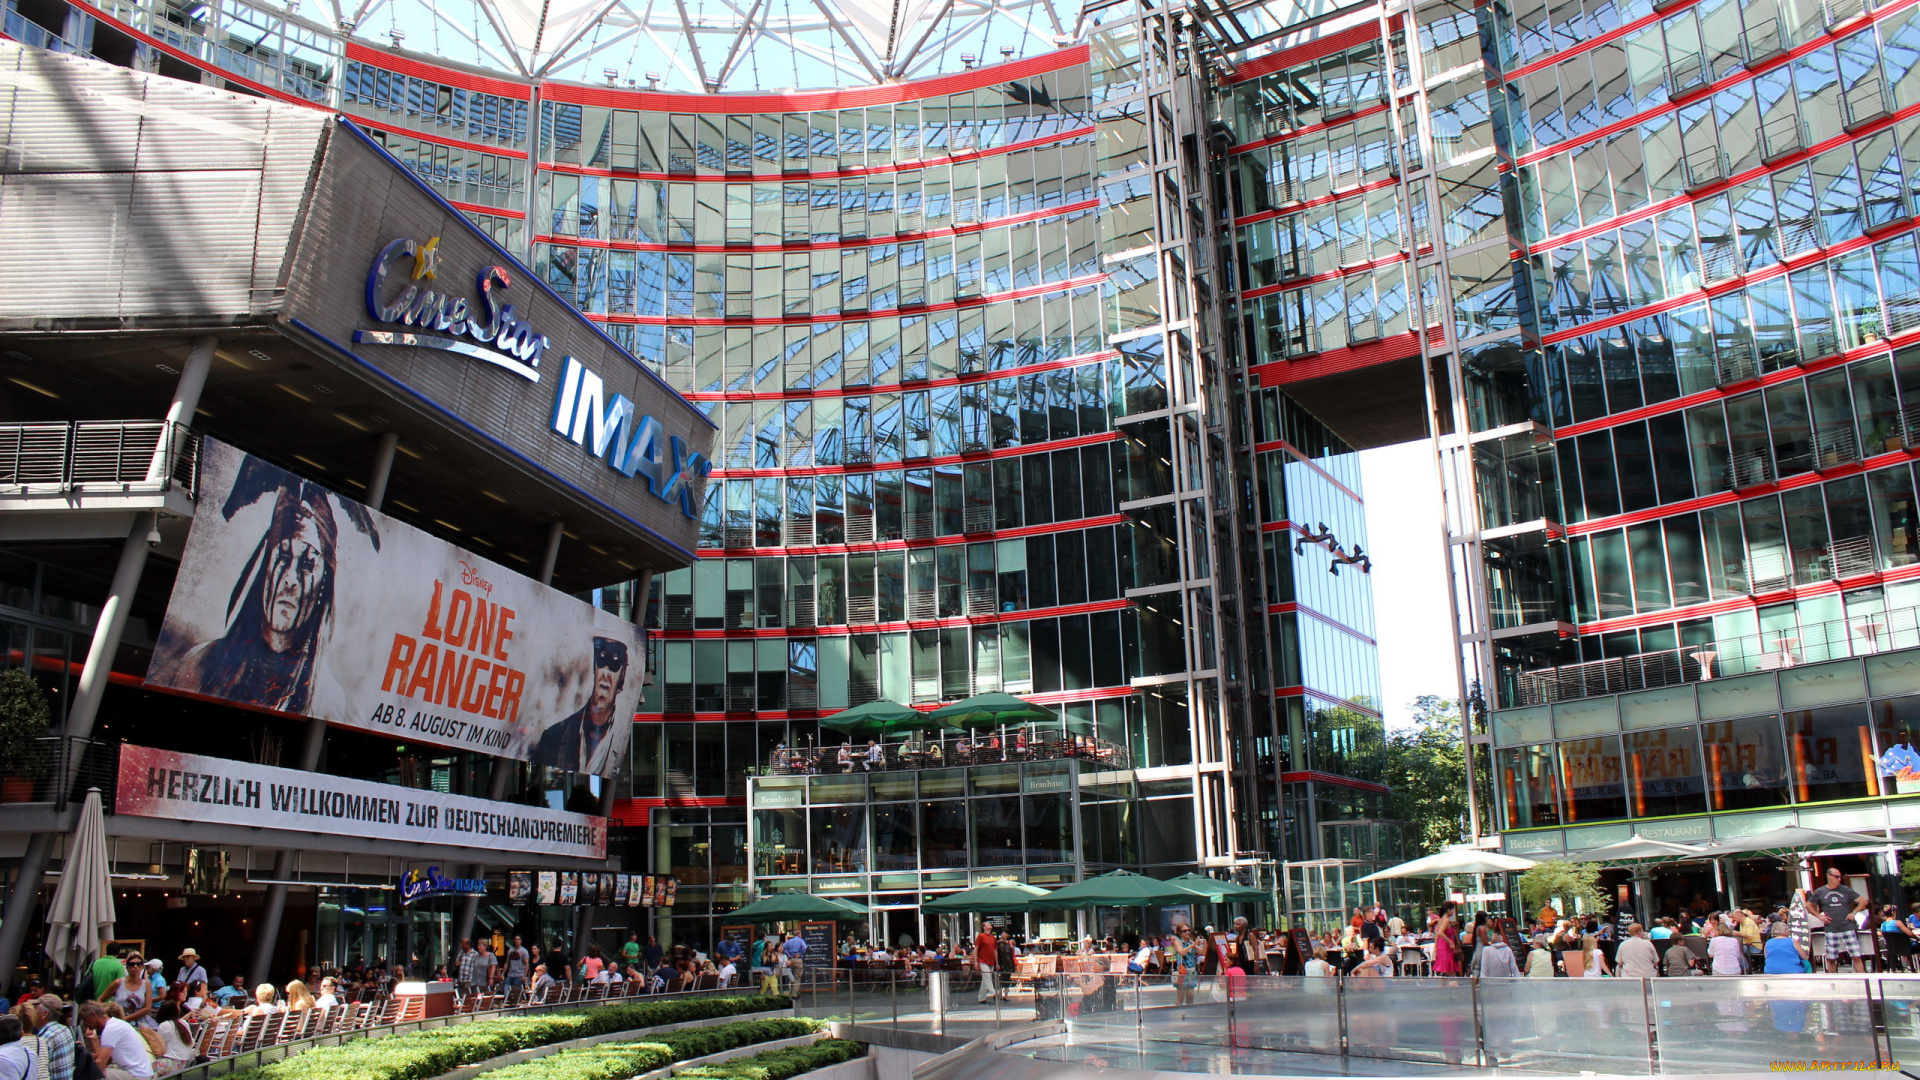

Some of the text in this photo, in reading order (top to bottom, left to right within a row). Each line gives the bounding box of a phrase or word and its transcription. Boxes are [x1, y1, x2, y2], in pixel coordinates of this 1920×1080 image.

[366, 238, 550, 367] CineStar
[422, 579, 516, 662] LONE
[381, 633, 526, 723] RANGER
[371, 703, 511, 749] AB 8. AUGUST IM KINO
[1030, 780, 1064, 789] Brauhaus
[147, 767, 597, 846] HERZLICH WILLKOMMEN ZUR DEUTSCHLANDPREMIERE
[760, 796, 795, 804] Brauhaus
[1641, 825, 1703, 839] RESTAURANT
[1509, 837, 1558, 849] Heineken
[456, 878, 488, 893] IMAX
[819, 881, 861, 890] Lindenbräu
[977, 874, 1018, 884] Lindenbräu
